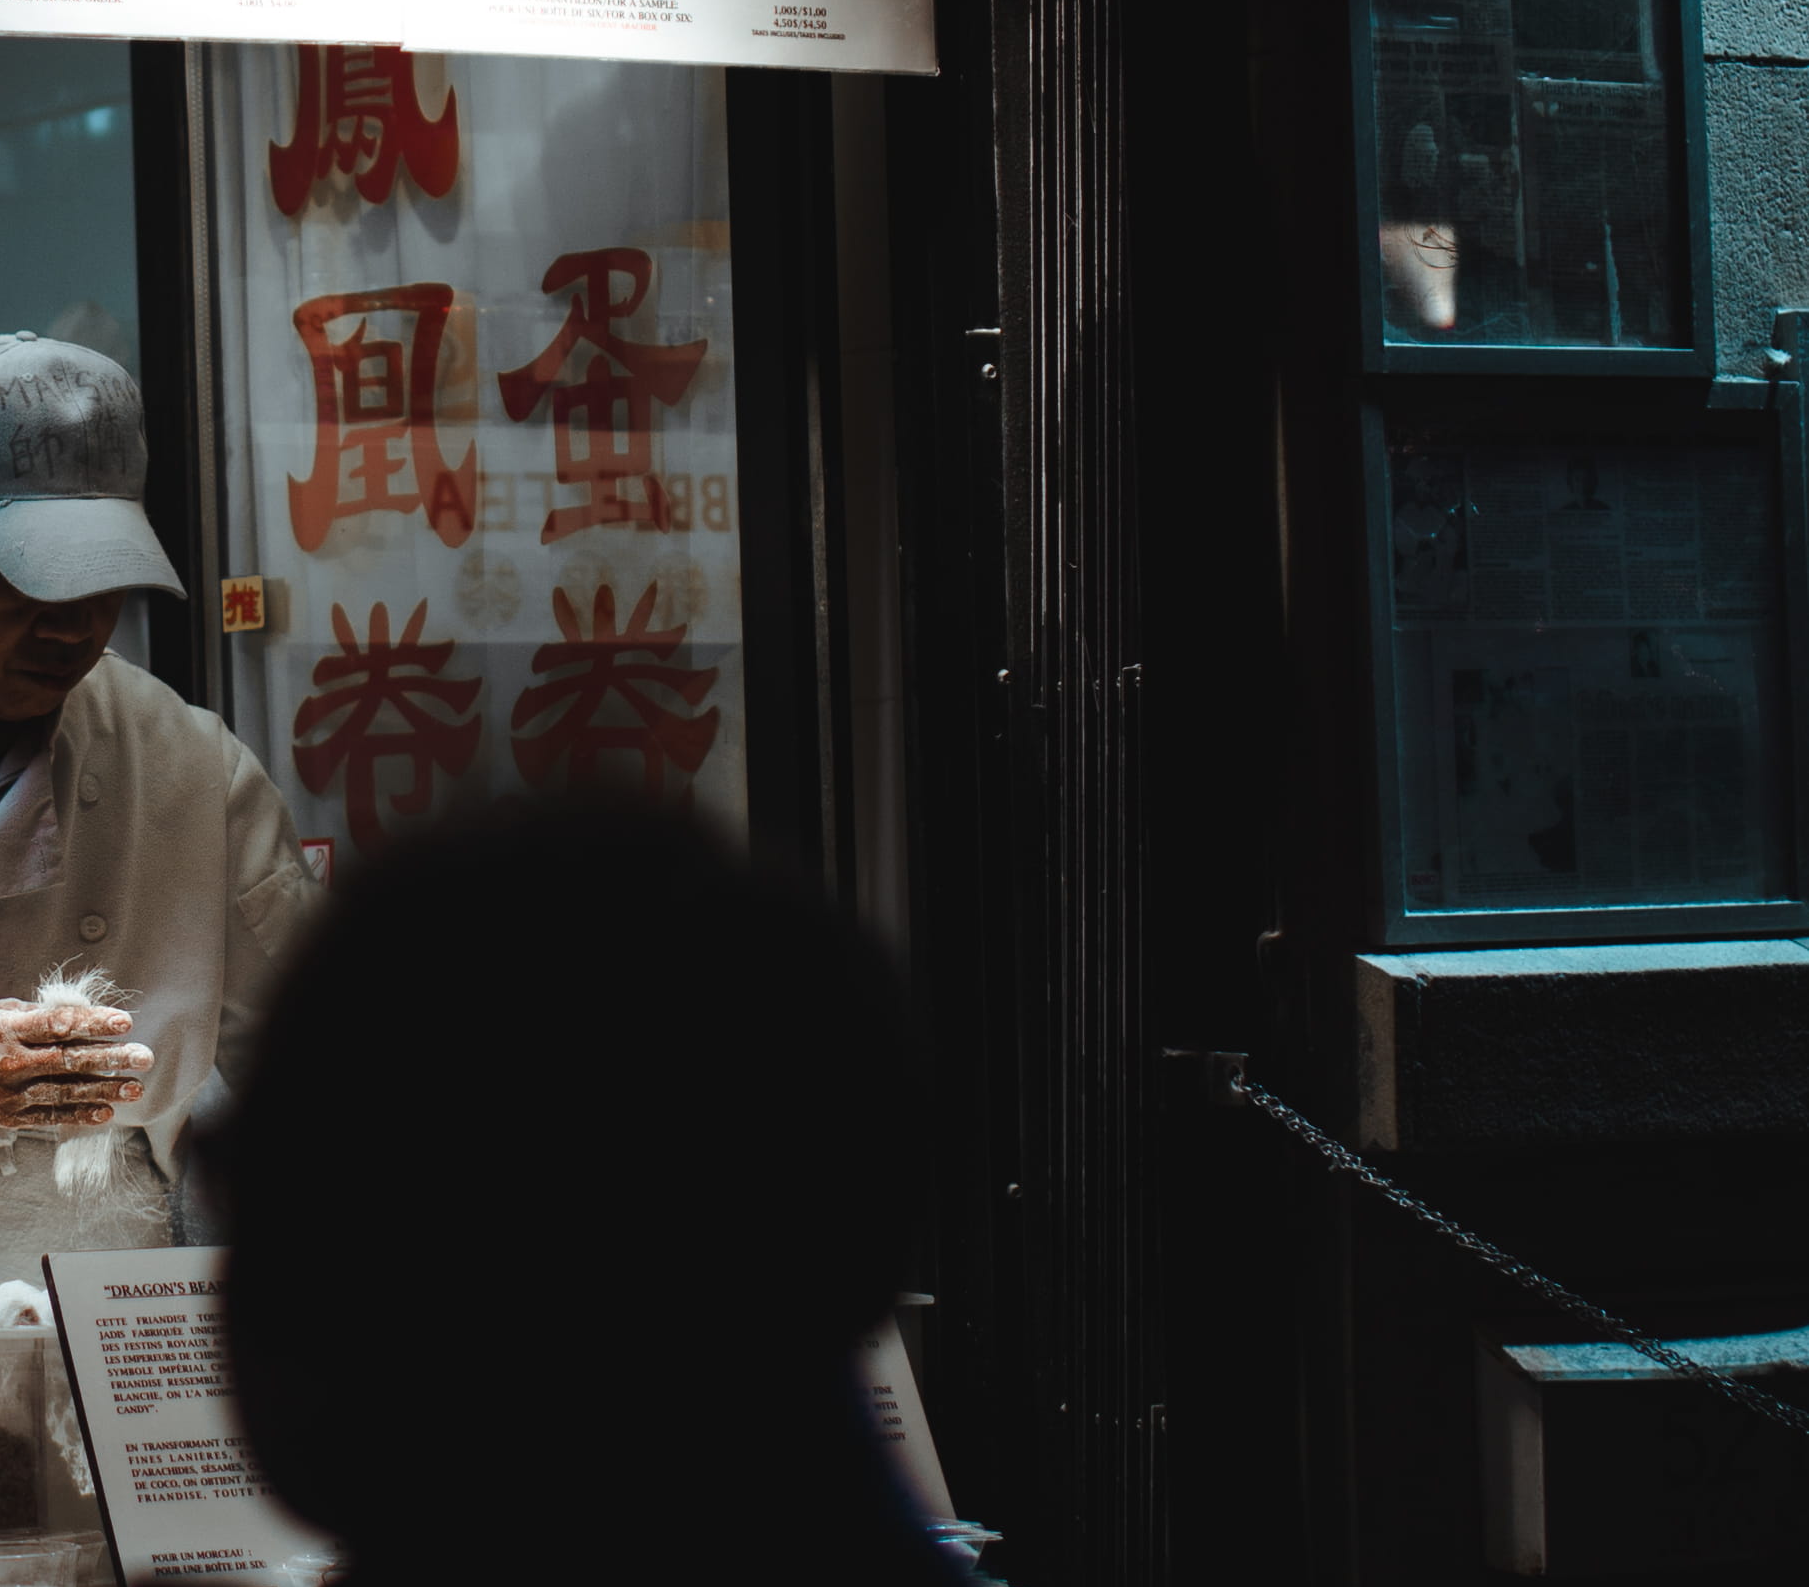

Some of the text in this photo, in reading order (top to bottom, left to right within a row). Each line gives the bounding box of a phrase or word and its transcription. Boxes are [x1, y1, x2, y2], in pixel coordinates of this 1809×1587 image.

[224, 582, 262, 628] 推
[95, 1314, 188, 1328] CETTE FRIANDISE
[99, 1325, 185, 1341] JADIS FABRIQUÉE
[101, 1338, 209, 1353] DES FESTINS ROYAUX
[122, 1351, 177, 1364] EMPEREURS
[107, 1361, 207, 1378] SYMBOLE IMPÉRIAL
[110, 1374, 223, 1390] FRIANDISE RESSEMBLE
[113, 1390, 163, 1403] BLANCHE,
[142, 1437, 221, 1453] TRANSFORMANT
[128, 1454, 163, 1466] FINES
[151, 1547, 244, 1564] POUR MORCEAU
